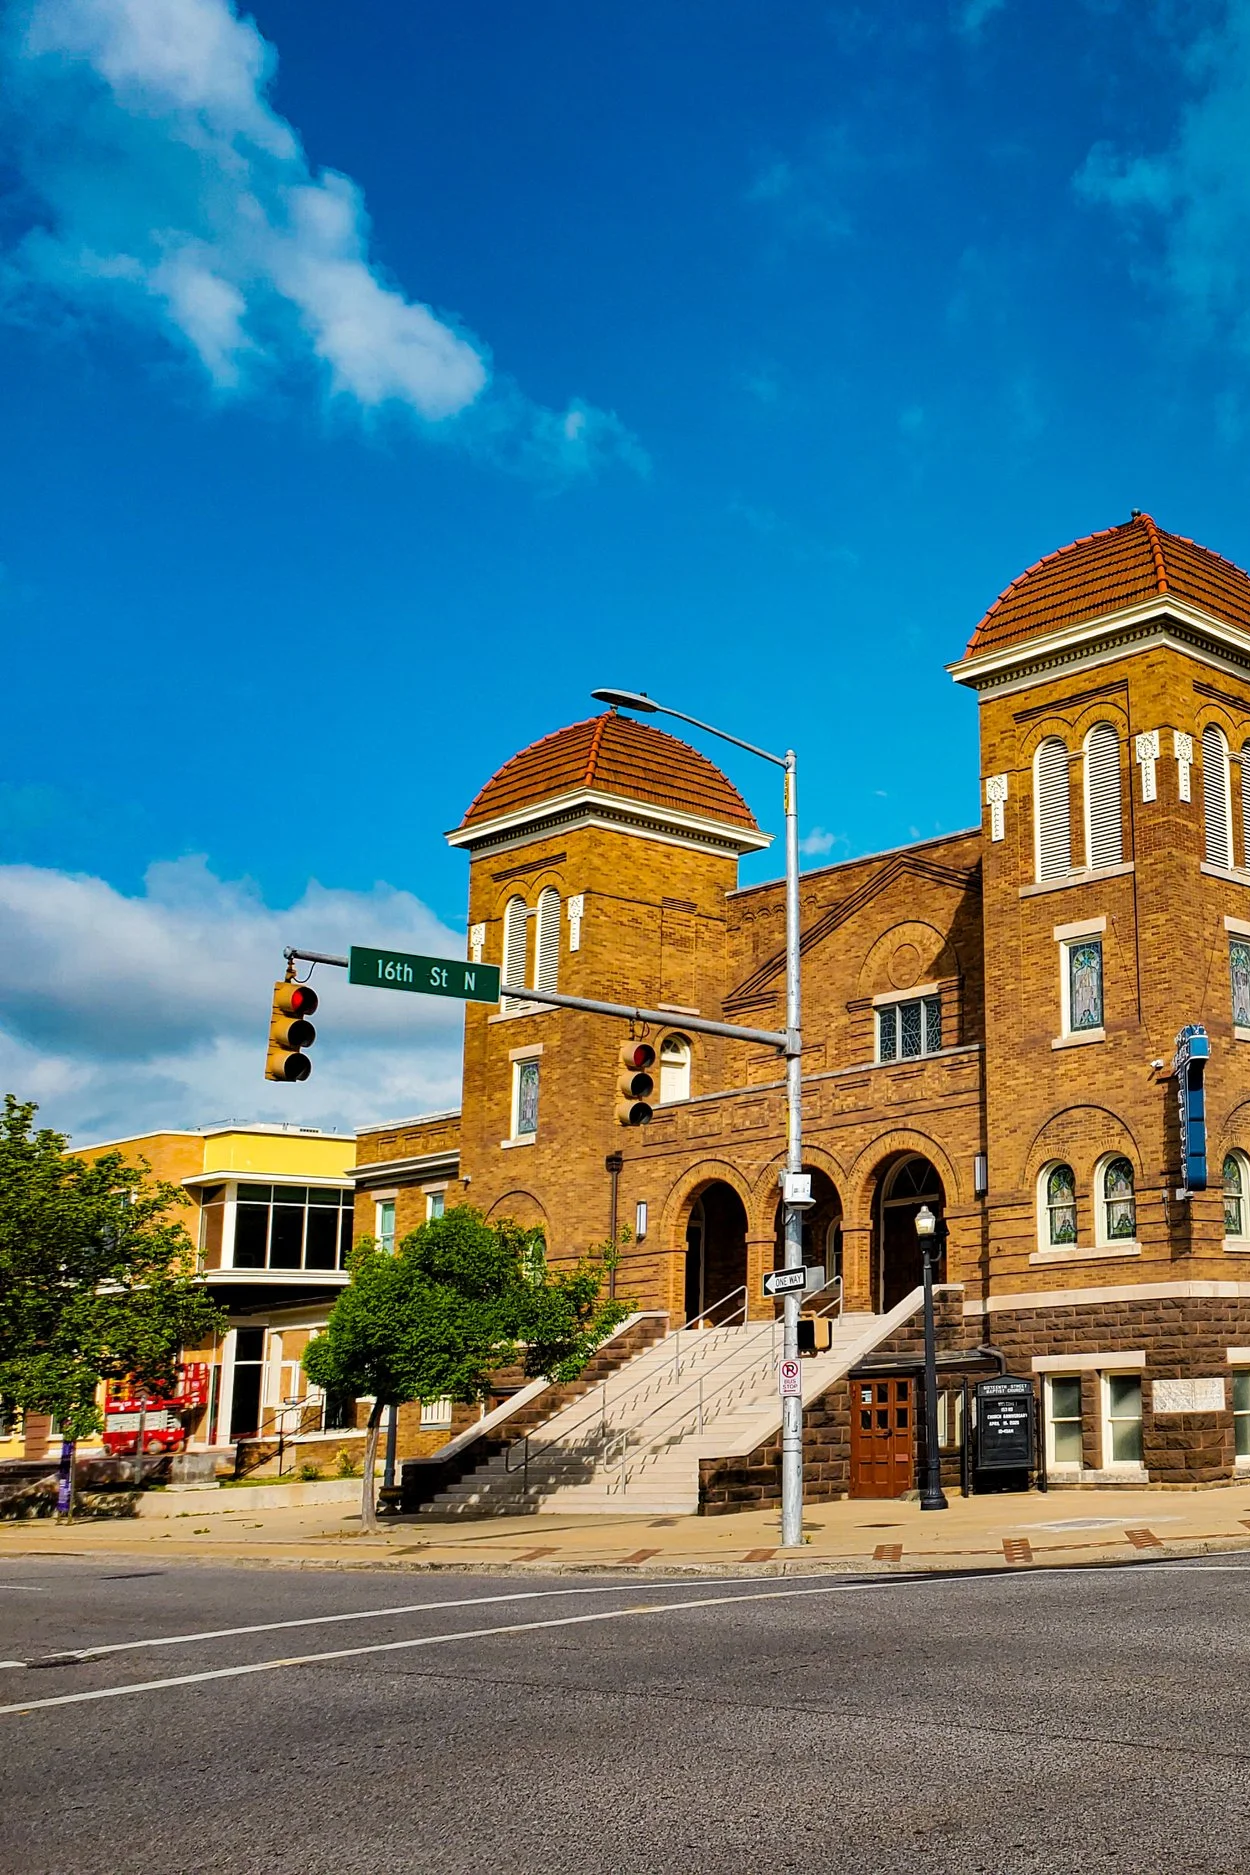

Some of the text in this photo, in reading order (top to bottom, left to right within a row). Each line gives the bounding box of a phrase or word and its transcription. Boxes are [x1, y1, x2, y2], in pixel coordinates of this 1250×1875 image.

[377, 959, 476, 991] 16th St N
[775, 1273, 802, 1288] ONE WAY
